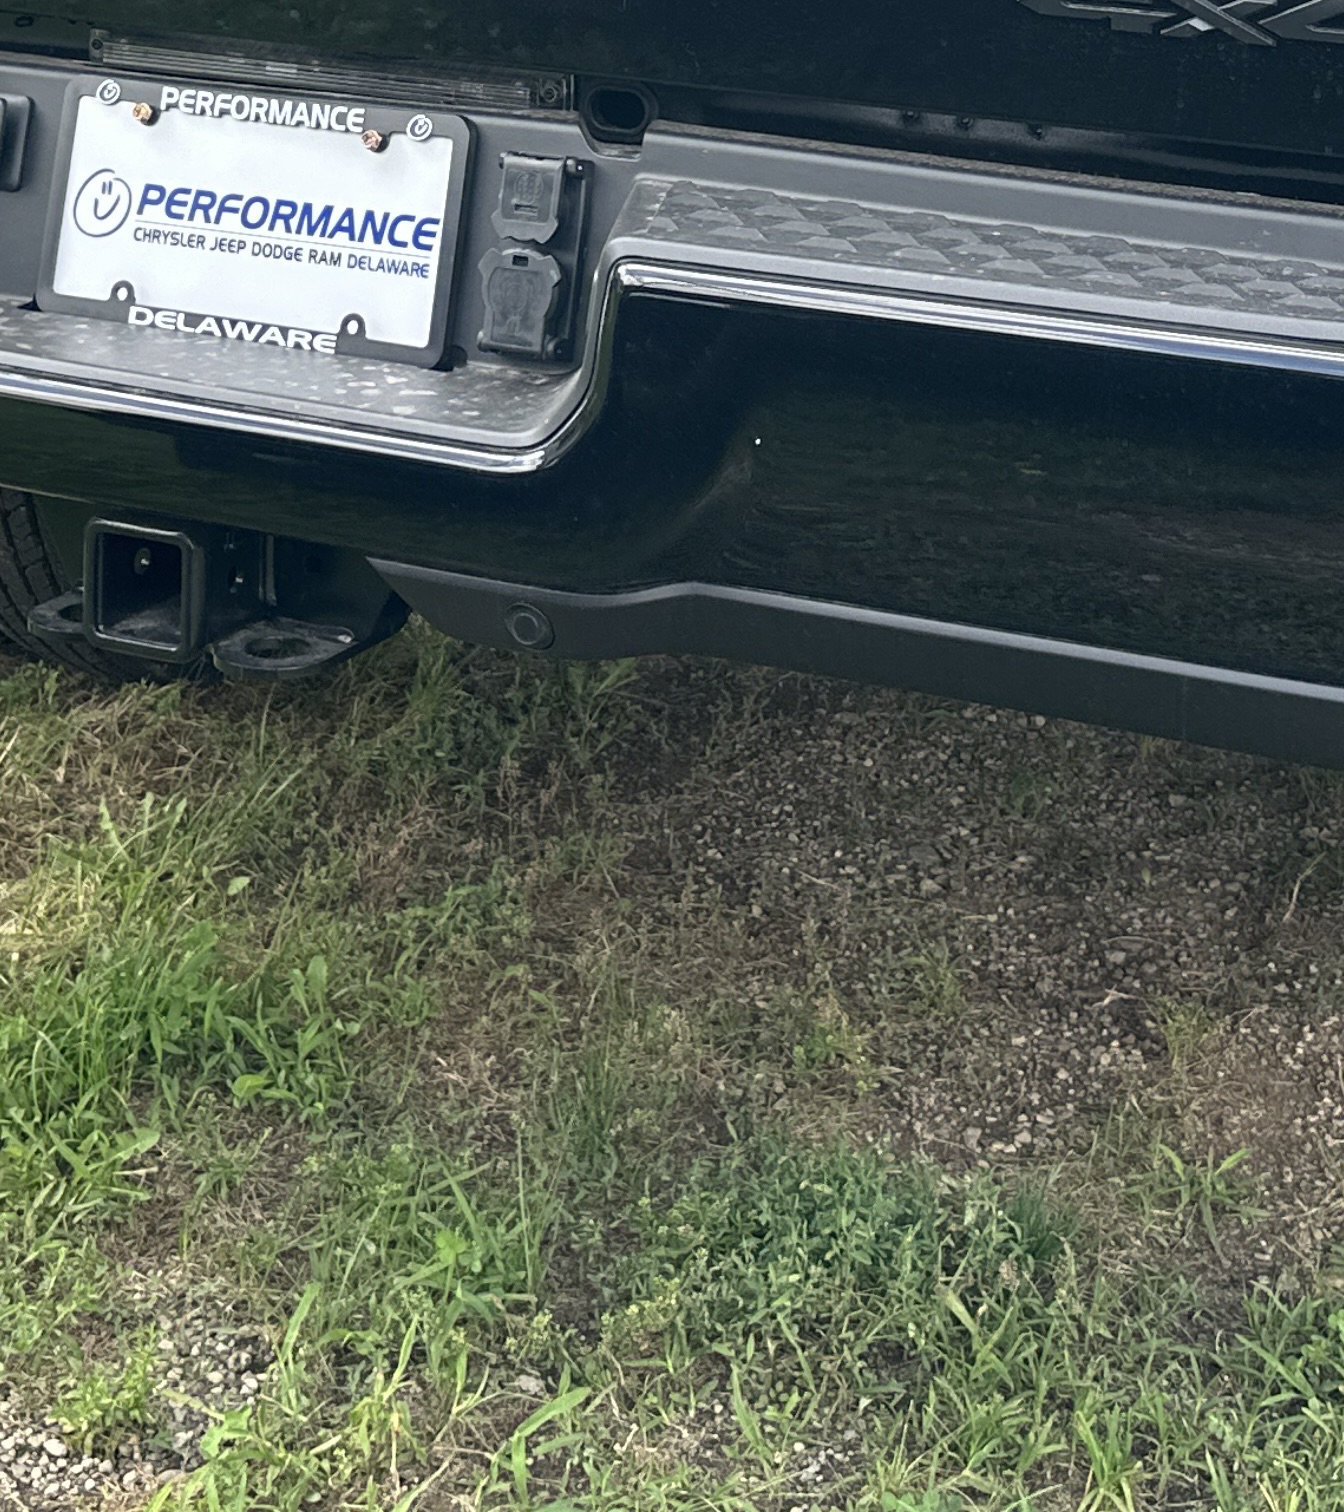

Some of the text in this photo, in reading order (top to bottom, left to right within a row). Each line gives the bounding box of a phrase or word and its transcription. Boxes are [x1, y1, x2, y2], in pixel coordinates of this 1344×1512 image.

[160, 86, 367, 133] PERFORMANCE
[136, 183, 441, 252] PERFORMANCE
[133, 226, 431, 280] CHRYSLER JEEP DODGE RAM DELAWARE
[127, 305, 339, 355] DELAWARE
